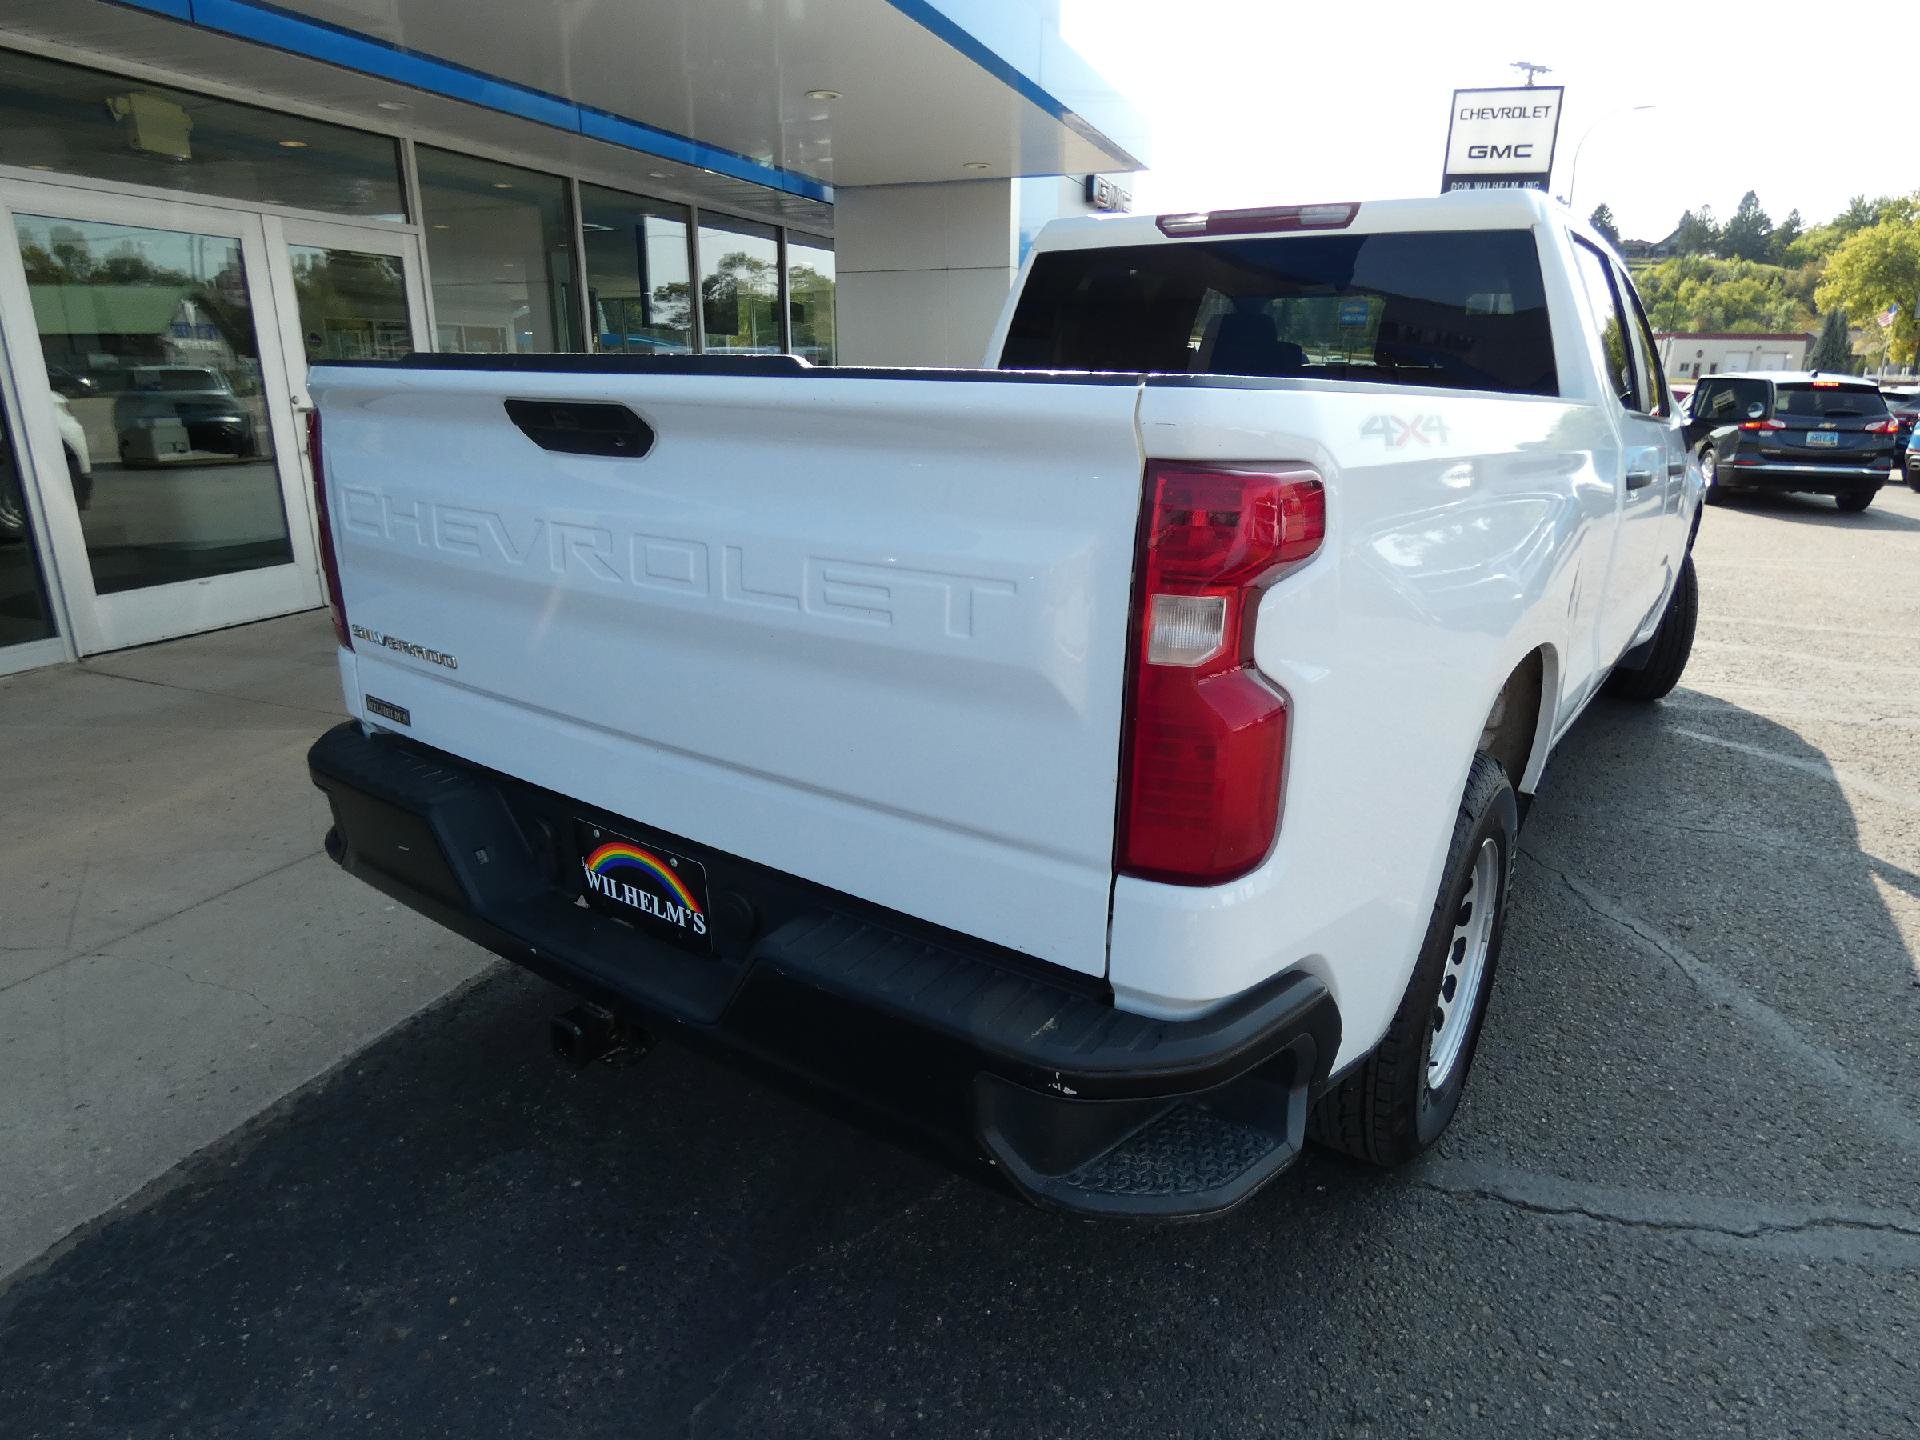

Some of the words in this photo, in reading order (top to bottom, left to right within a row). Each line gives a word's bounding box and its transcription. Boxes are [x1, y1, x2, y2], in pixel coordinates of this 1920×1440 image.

[1460, 105, 1552, 120] CHEVROLET
[1468, 144, 1533, 159] GMC
[343, 485, 1017, 639] CHEVROLET
[352, 624, 458, 669] SILVERADO
[583, 864, 707, 935] WILHELM'S
